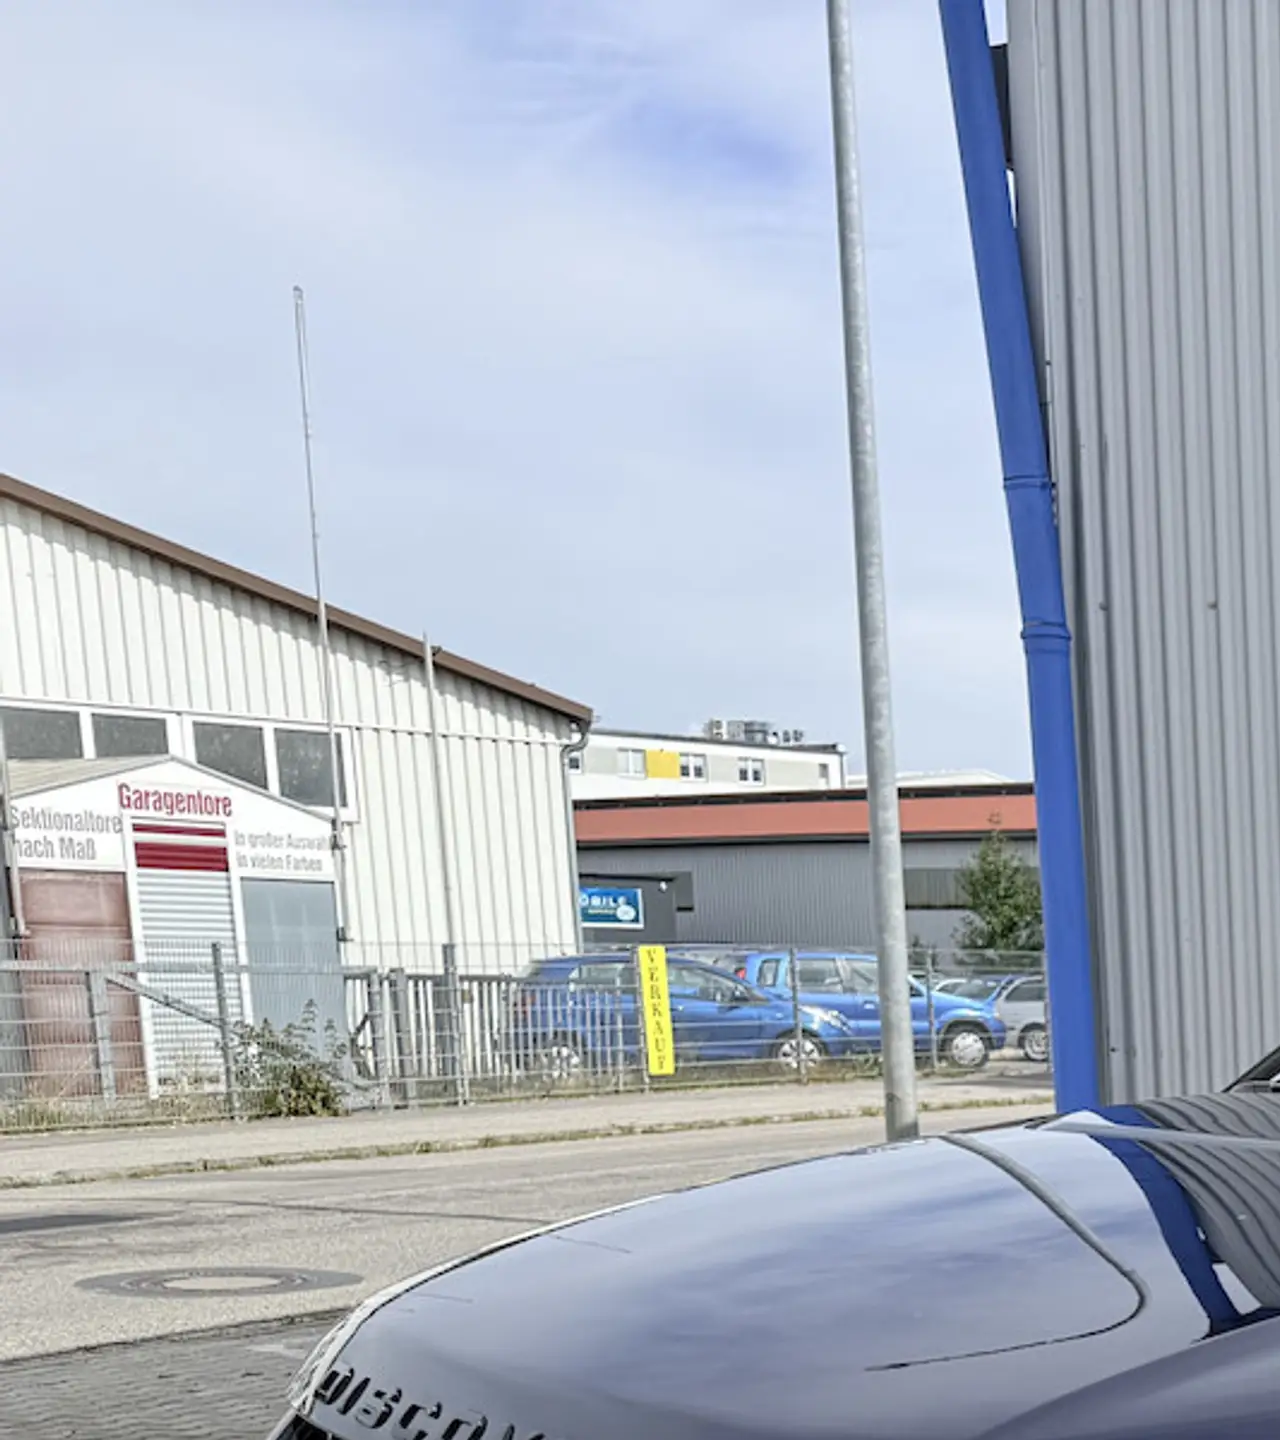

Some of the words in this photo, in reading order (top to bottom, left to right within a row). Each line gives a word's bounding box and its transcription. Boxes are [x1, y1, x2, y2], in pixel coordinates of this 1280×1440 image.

[117, 782, 233, 817] Garagentore
[9, 805, 124, 834] Sektionaltore
[58, 836, 98, 860] Maß
